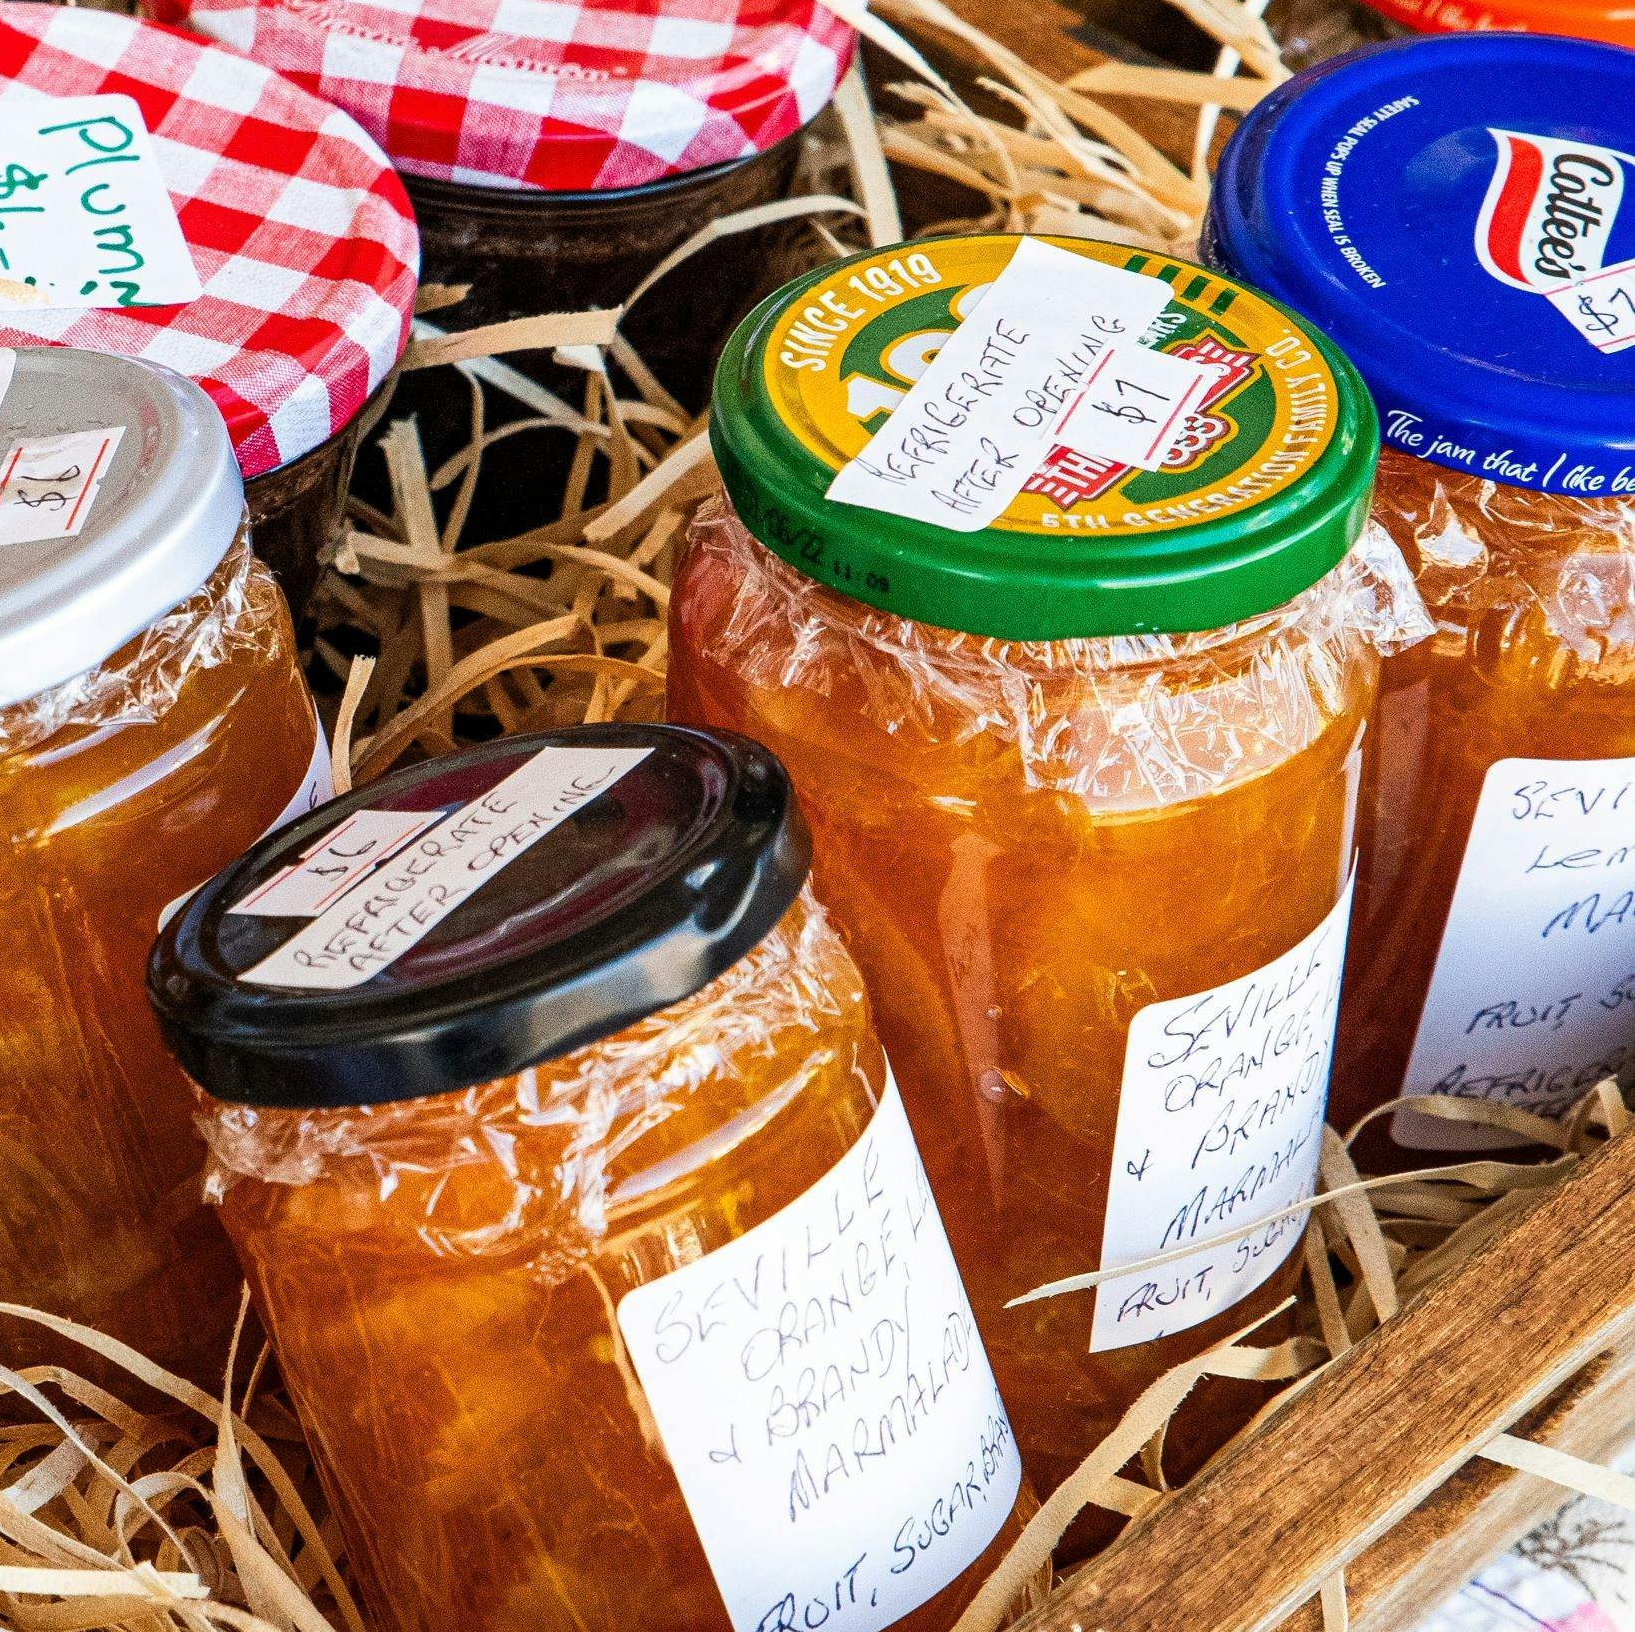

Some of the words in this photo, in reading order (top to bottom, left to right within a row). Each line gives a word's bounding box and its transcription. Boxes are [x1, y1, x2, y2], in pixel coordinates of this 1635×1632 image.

[1320, 176, 1339, 210] WHEN
[1322, 208, 1344, 235] SEAL
[1534, 152, 1615, 280] Cottee's
[1339, 246, 1388, 290] BROKEN
[779, 290, 866, 373] SINCE
[847, 253, 943, 303] 1919
[13, 464, 81, 512] $6
[930, 436, 1020, 516] AFTER
[1041, 512, 1111, 530] 5TH
[1121, 450, 1311, 530] GENERATION
[1282, 372, 1329, 445] FAMILY
[1387, 409, 1424, 448] The
[1417, 434, 1477, 466] jam
[1483, 449, 1539, 483] that
[1541, 452, 1567, 488] I
[1562, 464, 1606, 492] like
[293, 789, 519, 970] REFRIGERATE
[306, 839, 378, 882] $6
[349, 884, 469, 973] AFTER
[1147, 925, 1332, 1069] SEVILLE
[654, 1136, 884, 1364] SEVILLE
[1116, 1265, 1214, 1323] FRUIT,
[765, 1283, 911, 1447] BRANDY
